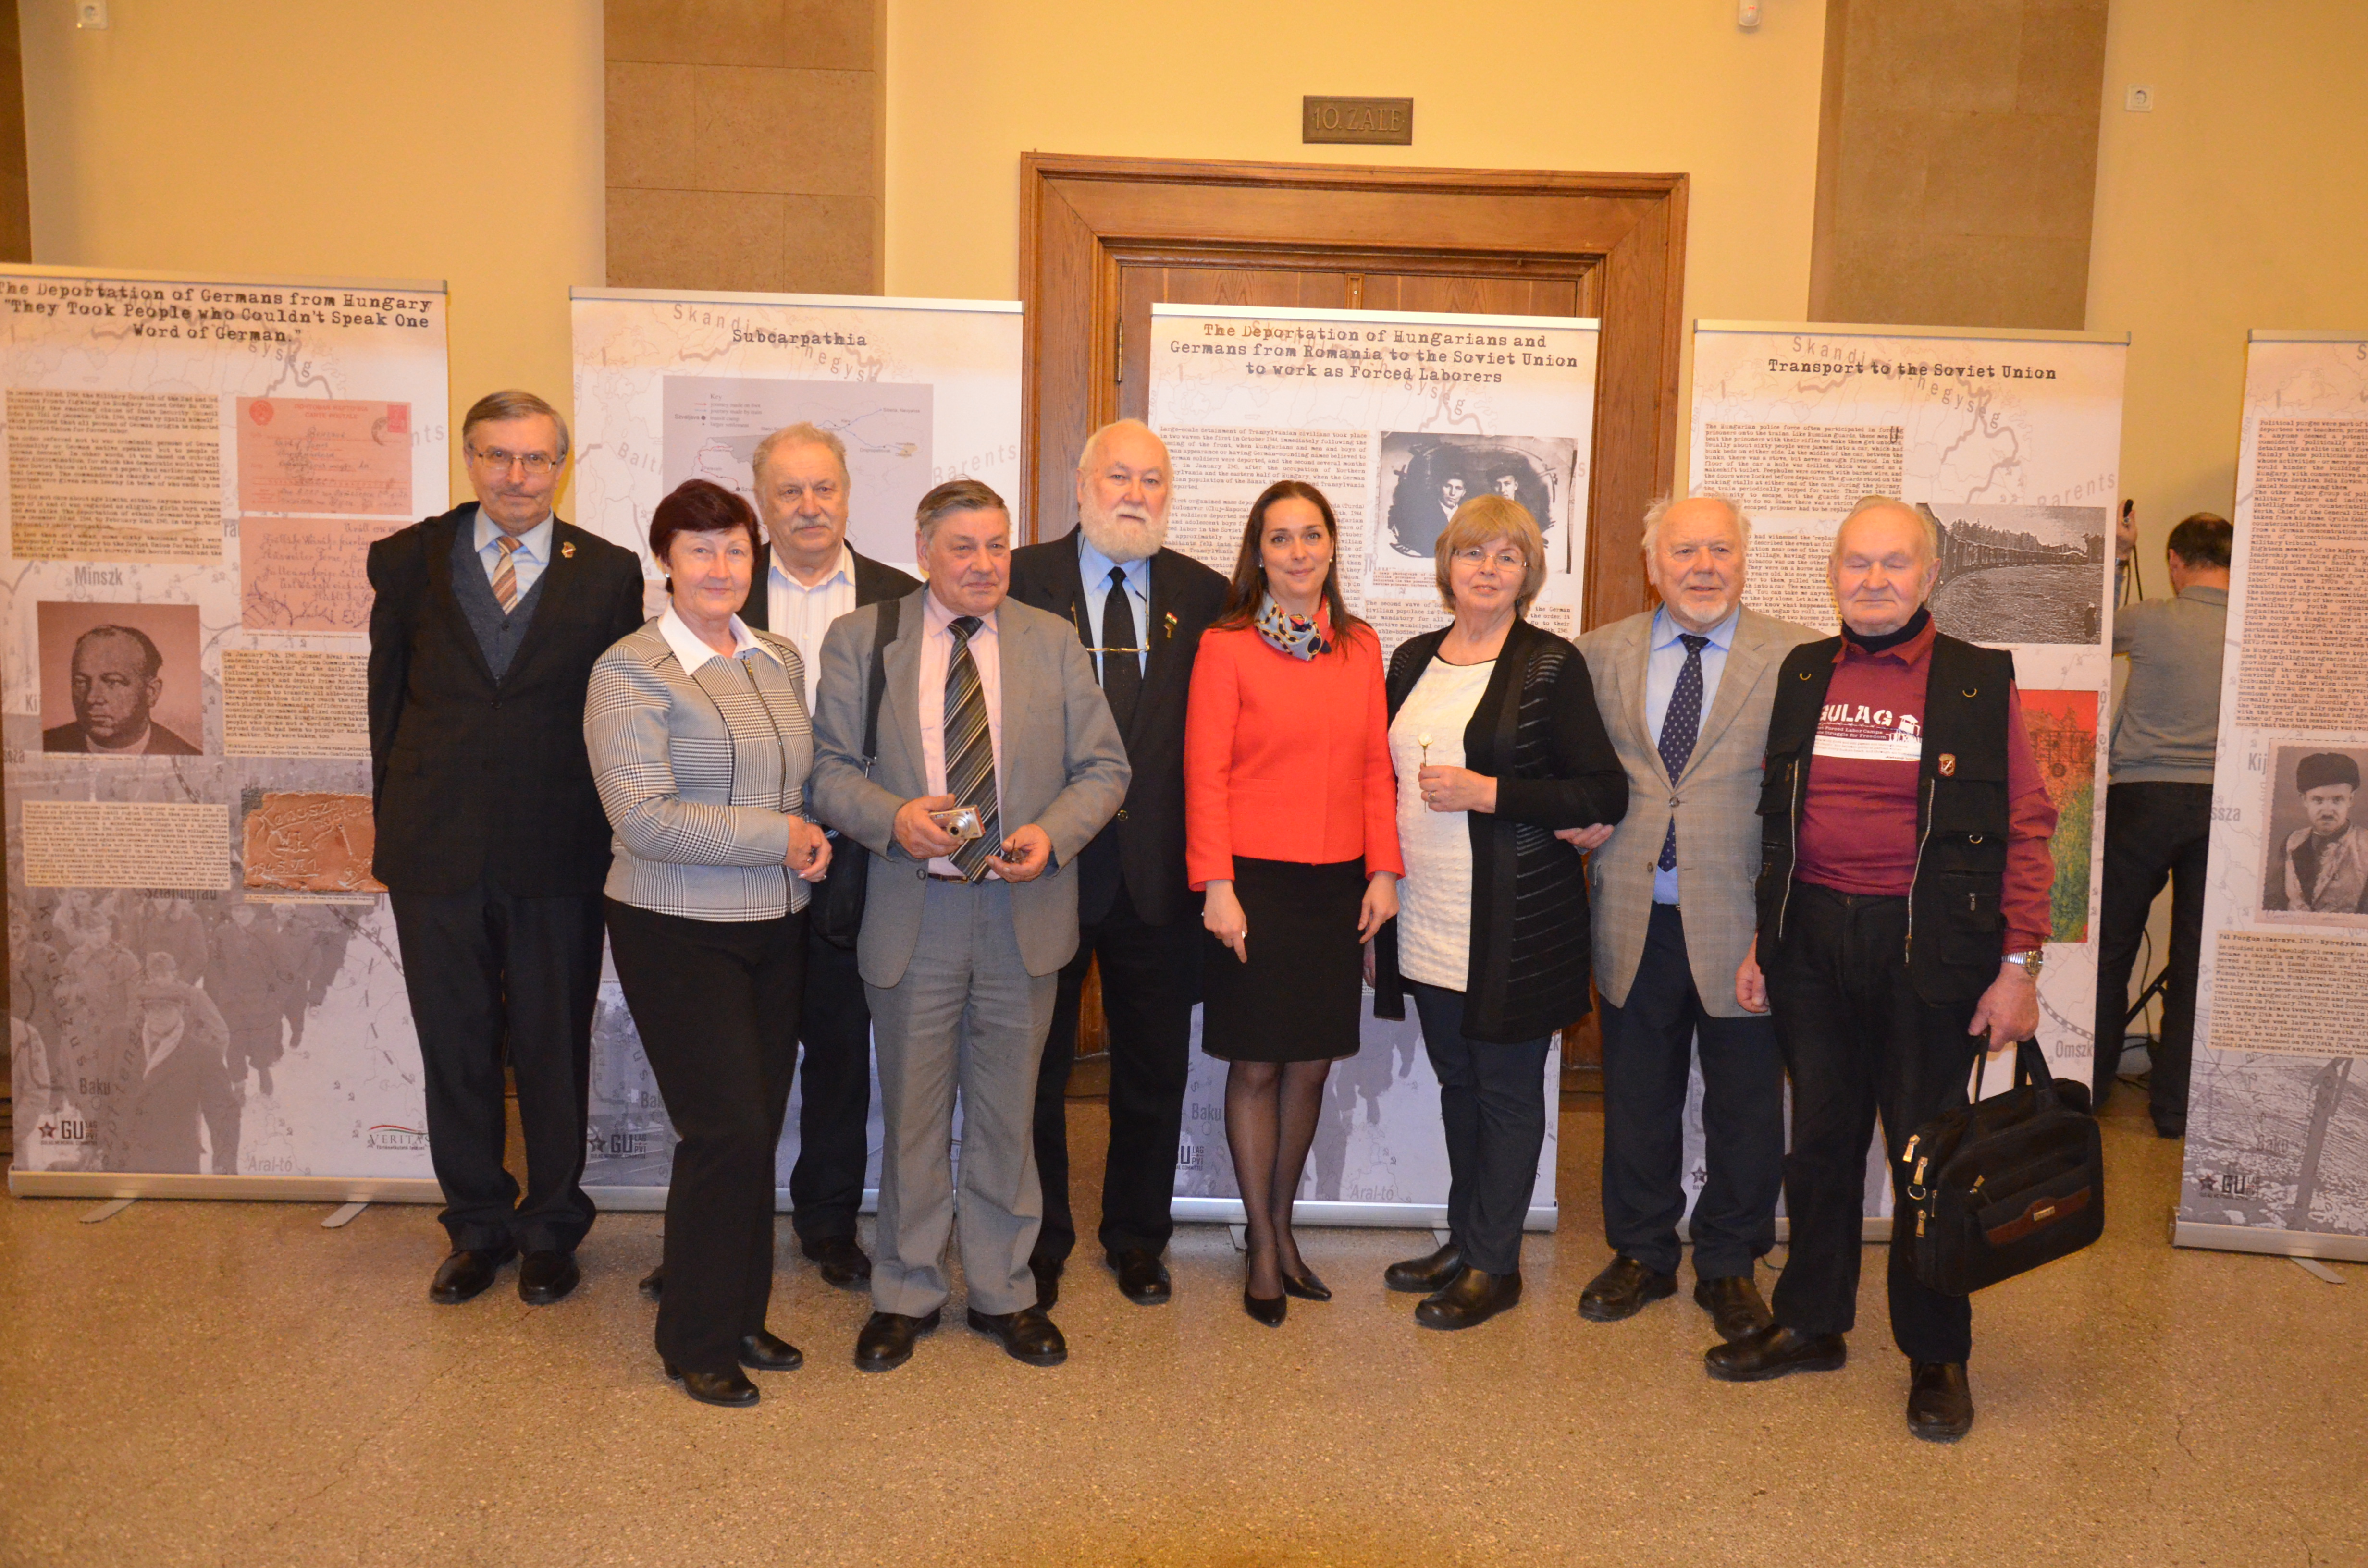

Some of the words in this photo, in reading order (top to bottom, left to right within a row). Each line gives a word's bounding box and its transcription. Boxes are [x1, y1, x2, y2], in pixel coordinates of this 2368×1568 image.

[1313, 107, 1342, 130] 10.
[35, 285, 165, 300] Deportation
[171, 288, 195, 301] of
[200, 289, 283, 304] Germans
[289, 292, 336, 306] from
[342, 294, 434, 312] Hungary
[5, 299, 58, 316] "They
[67, 301, 113, 316] Took
[125, 304, 190, 321] People
[198, 307, 234, 323] who
[242, 308, 324, 323] Couldn't
[332, 311, 386, 327] Speak
[395, 314, 428, 328] One
[132, 323, 181, 338] Word
[186, 326, 210, 339] of
[214, 327, 301, 342] German."
[733, 330, 866, 346] Subcarpathia
[1203, 324, 1235, 336] The
[1242, 326, 1359, 341] Deportation
[1365, 330, 1387, 342] of
[1393, 331, 1507, 346] Hungarians
[1513, 335, 1546, 347] and
[1171, 341, 1246, 355] Germans
[1253, 343, 1296, 356] from
[1303, 345, 1384, 359] Romania
[1388, 349, 1410, 361] to
[1415, 349, 1447, 362] the
[1453, 351, 1515, 364] Soviet
[1522, 353, 1577, 367] Union
[1246, 362, 1266, 374] to
[1272, 364, 1317, 376] work
[1324, 368, 1343, 377] as
[1350, 366, 1413, 379] Forced
[1418, 368, 1501, 382] Laborers
[1768, 359, 1864, 376] Transport
[1870, 361, 1891, 375] to
[1897, 364, 1928, 375] the
[1931, 364, 1995, 377] Soviet
[2002, 366, 2056, 379] Union
[933, 445, 1017, 487] Barents
[74, 566, 123, 585] Minszk
[1819, 704, 1893, 726] GULAG
[2056, 1040, 2094, 1058] Omszk
[80, 1078, 111, 1095] Baku
[1192, 1103, 1221, 1121] Baku
[62, 1120, 83, 1139] GU
[611, 1134, 632, 1153] GU
[1350, 1184, 1394, 1200] Aral-tó
[2222, 1175, 2245, 1194] GU
